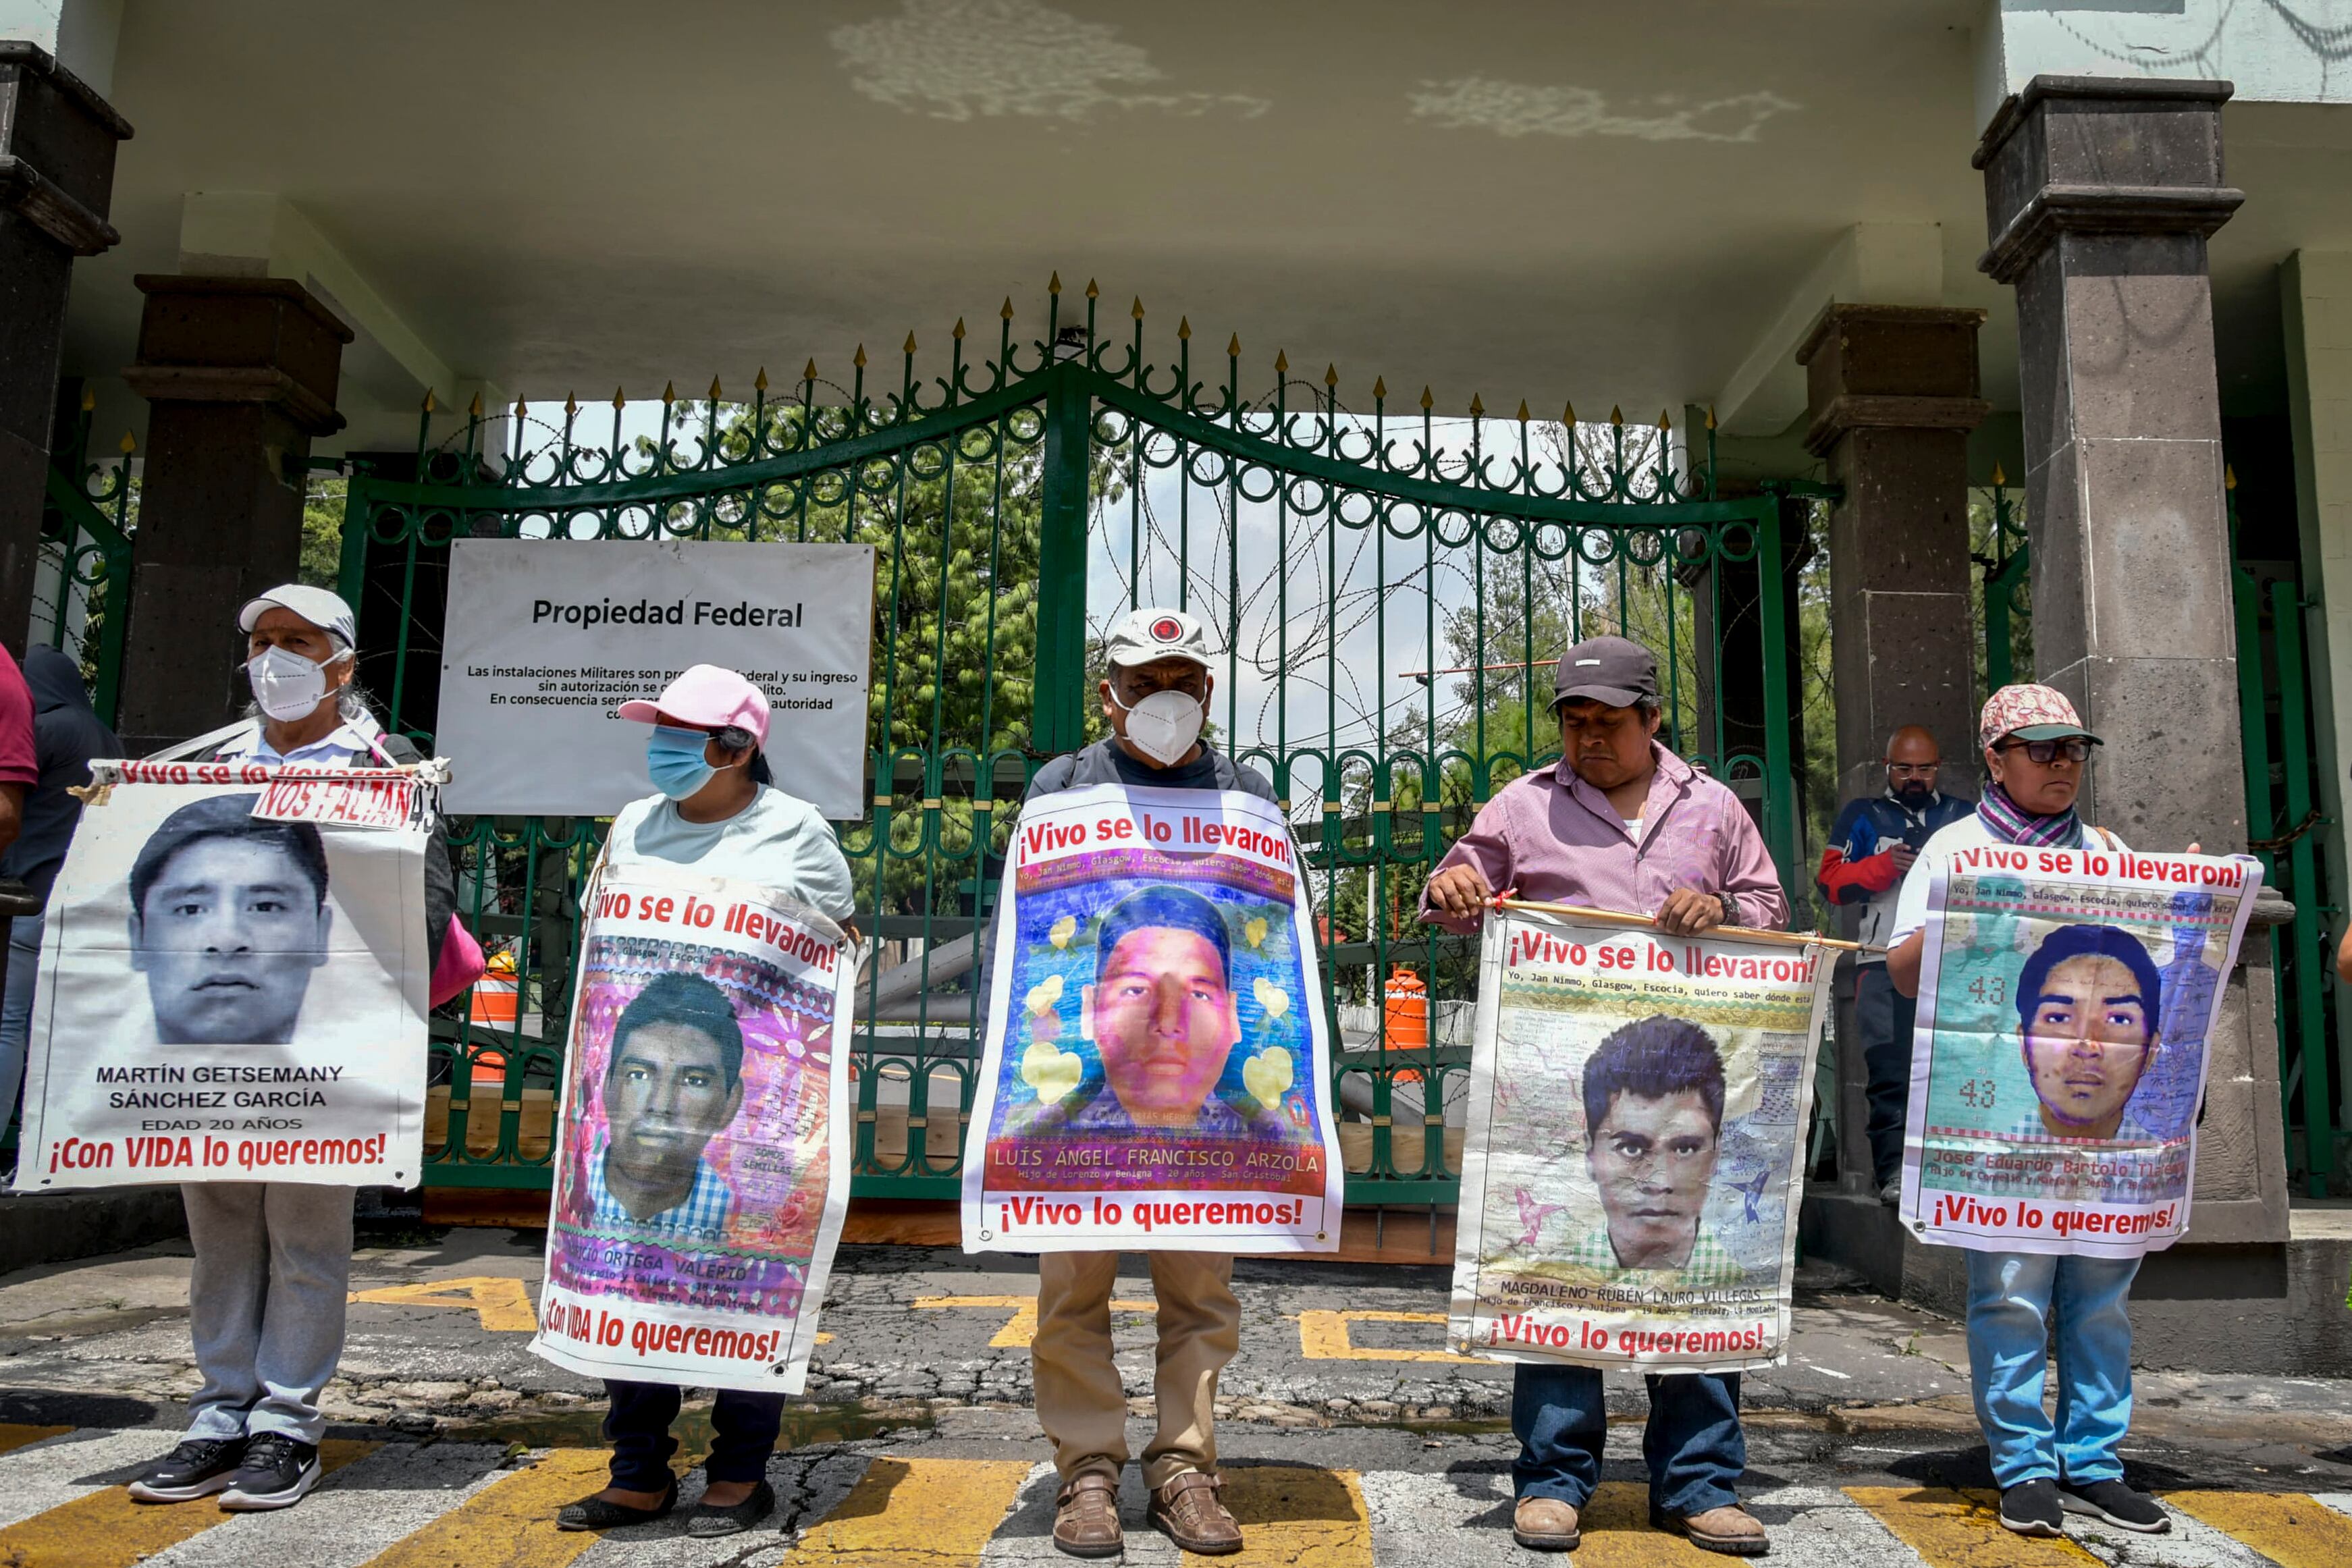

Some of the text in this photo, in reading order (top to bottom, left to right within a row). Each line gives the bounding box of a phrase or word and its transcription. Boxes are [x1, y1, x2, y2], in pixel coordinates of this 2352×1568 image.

[532, 597, 803, 629] Propiedad Federal
[468, 666, 489, 677] Las
[493, 666, 577, 678] instalaciones
[581, 667, 635, 679] Militares
[639, 670, 660, 679] son
[735, 669, 778, 682] deral
[781, 673, 789, 684] y
[793, 673, 806, 682] su
[811, 671, 857, 686] ingreso
[539, 680, 557, 692] sin
[561, 680, 639, 693] autorización
[643, 684, 657, 693] se
[758, 683, 786, 695] lito.
[490, 694, 506, 705] En
[510, 695, 597, 705] consecuencia
[602, 694, 635, 705] será
[771, 698, 833, 710] autoridad
[122, 760, 189, 785] Vivo
[197, 765, 232, 784] se
[240, 764, 271, 784] lo
[256, 778, 317, 817] NOS
[1020, 813, 1291, 865] ¡Vivo se lo llevaron!
[1019, 871, 1033, 880] Yo,
[1038, 867, 1052, 877] Jan
[1057, 861, 1086, 873] Nimmo,
[1091, 855, 1135, 866] Glasgow,
[1142, 853, 1186, 866] Escocia,
[1192, 859, 1226, 868] quiero
[1231, 861, 1251, 873] saber
[1953, 846, 2242, 889] ¡Vivo se lo llevaron!
[1954, 886, 1969, 896] Yo,
[1975, 886, 1991, 896] Jan
[1996, 888, 2027, 900] Nimmo,
[2033, 891, 2075, 903] Glasgow,
[2080, 895, 2120, 907] Escocia,
[2126, 898, 2158, 909] quiero
[2163, 900, 2189, 911] saber
[638, 895, 674, 923] se
[682, 896, 715, 928] lo
[724, 902, 837, 973] llevaron!
[622, 946, 662, 959] Glasgow,
[1509, 930, 1818, 983] ¡Vivo se lo llevaron!
[1508, 971, 1811, 1004] Yo, Jan Nimmo, Glasgow, Escocia, quiero saber dónde está
[1969, 975, 2006, 1005] 43
[97, 1064, 343, 1083] MARTÍN GETSEMANY
[109, 1088, 326, 1109] SÁNCHEZ GARCÍA
[1959, 1079, 1996, 1109] 43
[142, 1116, 302, 1131] EDAD 20 AÑOS
[49, 1133, 387, 1174] ¡Con VIDA lo queremos!
[743, 1159, 792, 1175] SEMILLAS
[754, 1147, 785, 1161] SOMOS
[995, 1145, 1318, 1172] LUÍS ÁNGEL FRANCISCO ARZOLA
[1933, 1150, 1975, 1166] José
[1985, 1155, 2054, 1173] Eduardo
[2063, 1159, 2128, 1177] Bartolo
[1018, 1169, 1291, 1182] Hijo de Lorenzo y Benigna 20 años San Cristóbal
[1930, 1166, 1954, 1177] Hijo
[1959, 1169, 1973, 1177] de
[1977, 1171, 2021, 1182] Cornelio
[2025, 1177, 2032, 1185] y
[1001, 1196, 1303, 1233] ¡Vivo lo queremos!
[1934, 1194, 2008, 1227] ¡Vivo
[2016, 1201, 2043, 1229] lo
[604, 1249, 664, 1271] ORTEGA
[675, 1261, 747, 1281] VALERIO
[604, 1283, 762, 1312] Monte Alegre, Malinaltepec
[622, 1273, 629, 1282] y
[696, 1282, 708, 1292] 18
[714, 1283, 739, 1295] Años
[1501, 1281, 1761, 1304] MAGDALENO RUBÉN LAURO VILLEGAS
[1507, 1297, 1518, 1306] de
[1524, 1299, 1573, 1309] Francisco
[1578, 1303, 1583, 1312] y
[1588, 1303, 1626, 1314] Juliana
[1642, 1306, 1652, 1315] 19
[1746, 1305, 1775, 1315] Montaña
[543, 1297, 780, 1362] ¡Con VIDA lo queremos!
[1489, 1313, 1764, 1359] ¡Vivo lo queremos!
